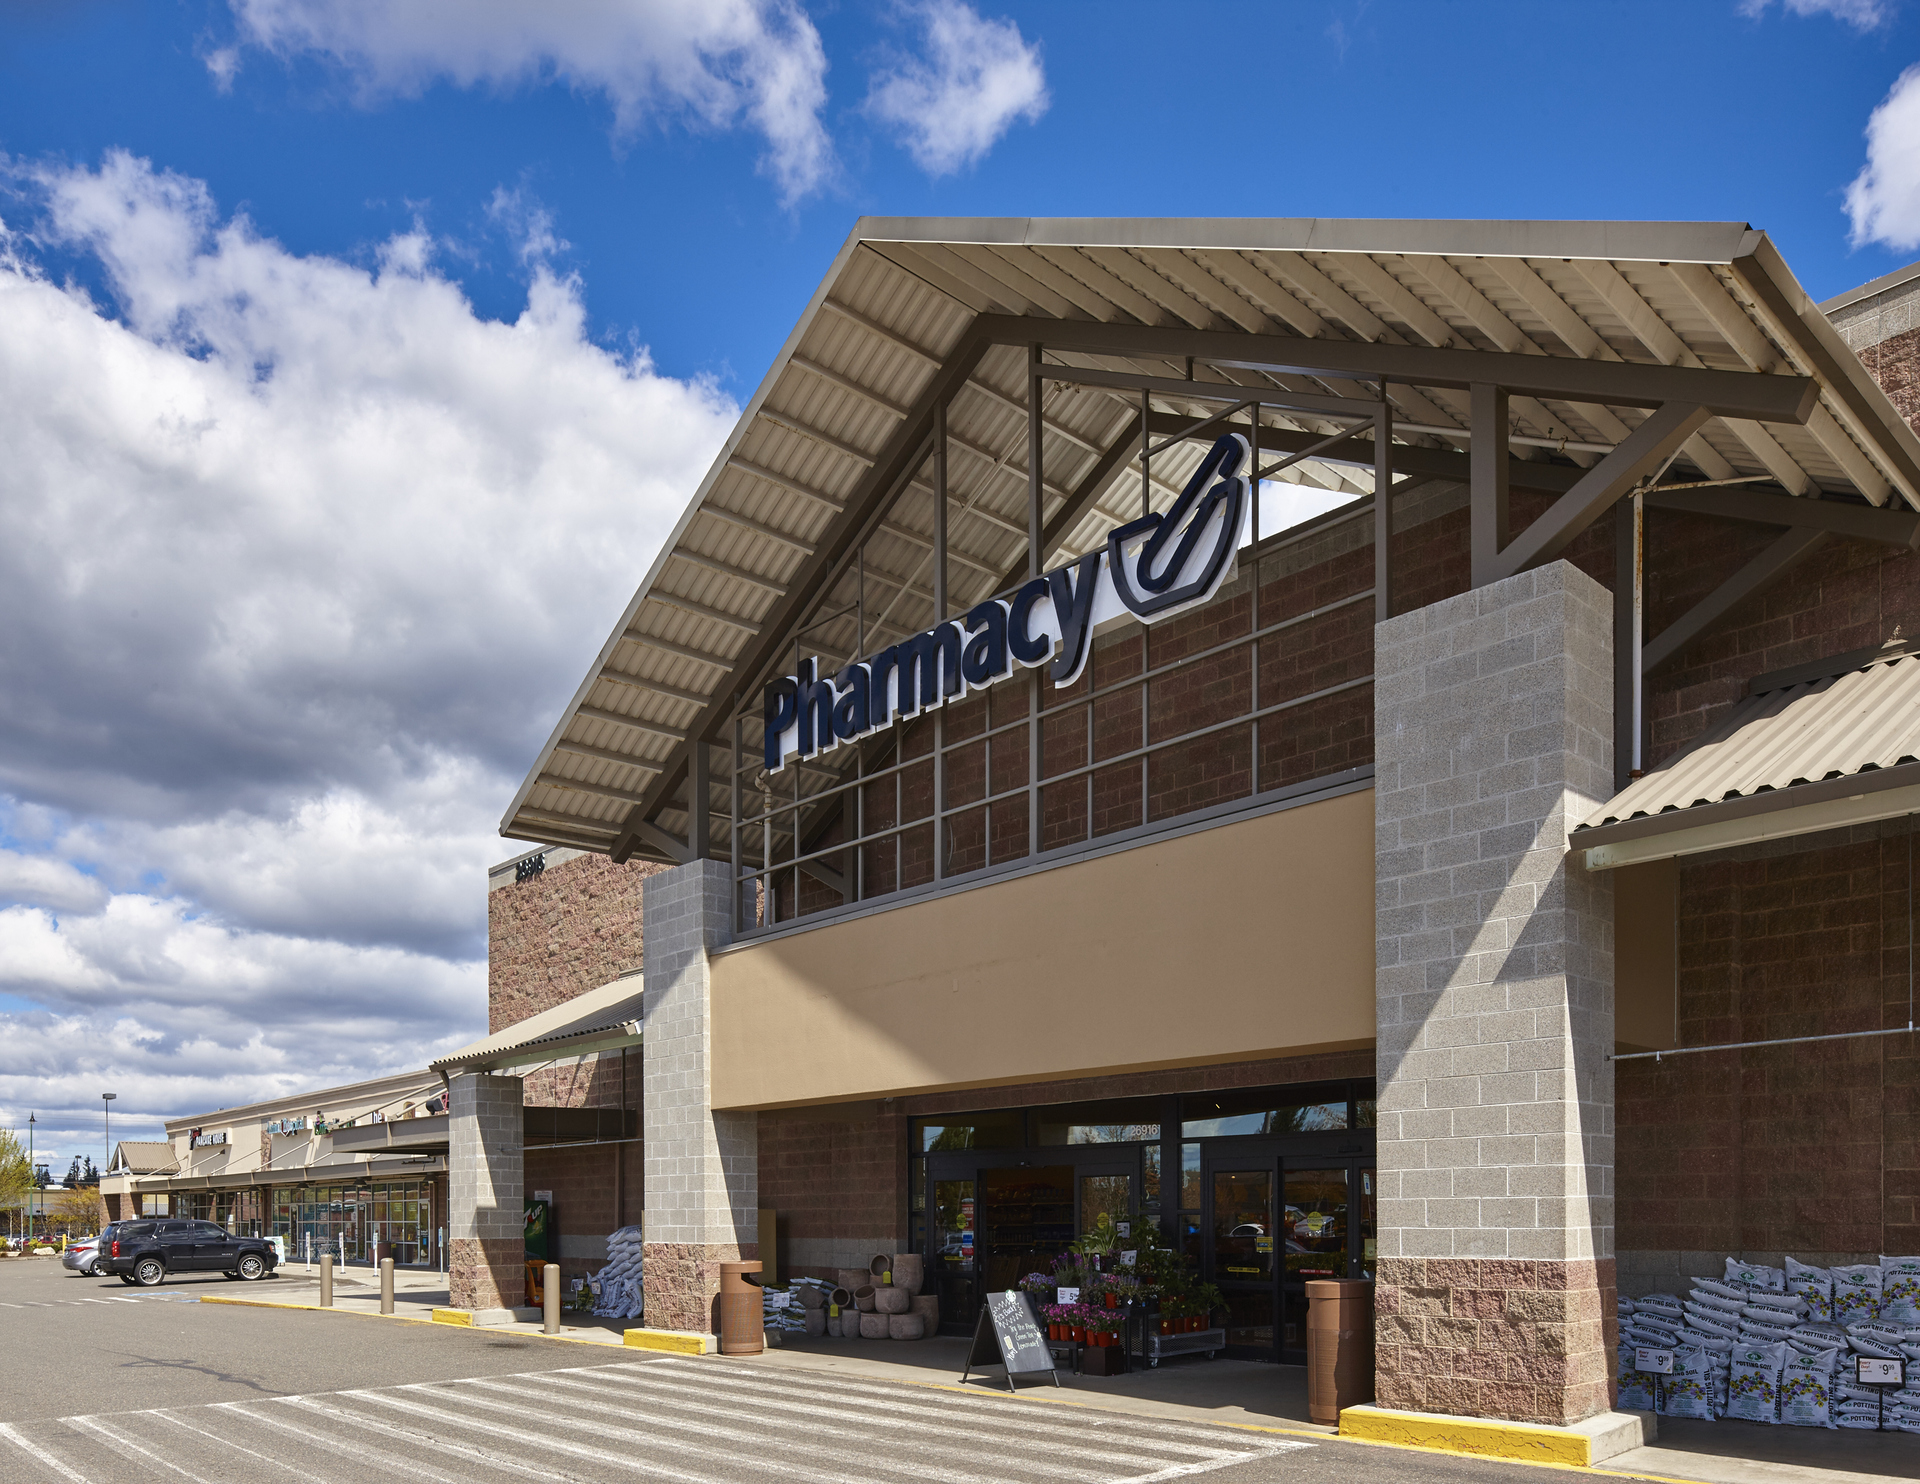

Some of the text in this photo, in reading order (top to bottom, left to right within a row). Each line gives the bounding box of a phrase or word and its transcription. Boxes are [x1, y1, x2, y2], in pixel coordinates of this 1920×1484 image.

[764, 552, 1100, 771] Pharmacy
[1130, 1124, 1158, 1136] 26916
[196, 1134, 212, 1146] PANCAKE
[212, 1132, 225, 1145] HOUSE
[1730, 1284, 1742, 1292] SOIL
[1665, 1301, 1677, 1309] SOIL
[1755, 1305, 1779, 1313] POTTING
[1644, 1313, 1679, 1326] POTTING SOIL
[1697, 1315, 1720, 1326] POTTING
[1749, 1319, 1773, 1328] POTTING
[1639, 1326, 1672, 1339] POTTING SOIL
[1689, 1330, 1712, 1340] POTTING
[1748, 1333, 1772, 1342] POTTING
[1802, 1330, 1842, 1343] POTTING SOIL
[1638, 1339, 1660, 1348] POTTING
[1863, 1338, 1889, 1352] POTTING
[1736, 1360, 1759, 1368] POTTING
[1853, 1384, 1880, 1394] POTTING
[1705, 1382, 1713, 1407] POTTING
[1774, 1384, 1782, 1411] POTTING
[1853, 1401, 1880, 1410] POTTING
